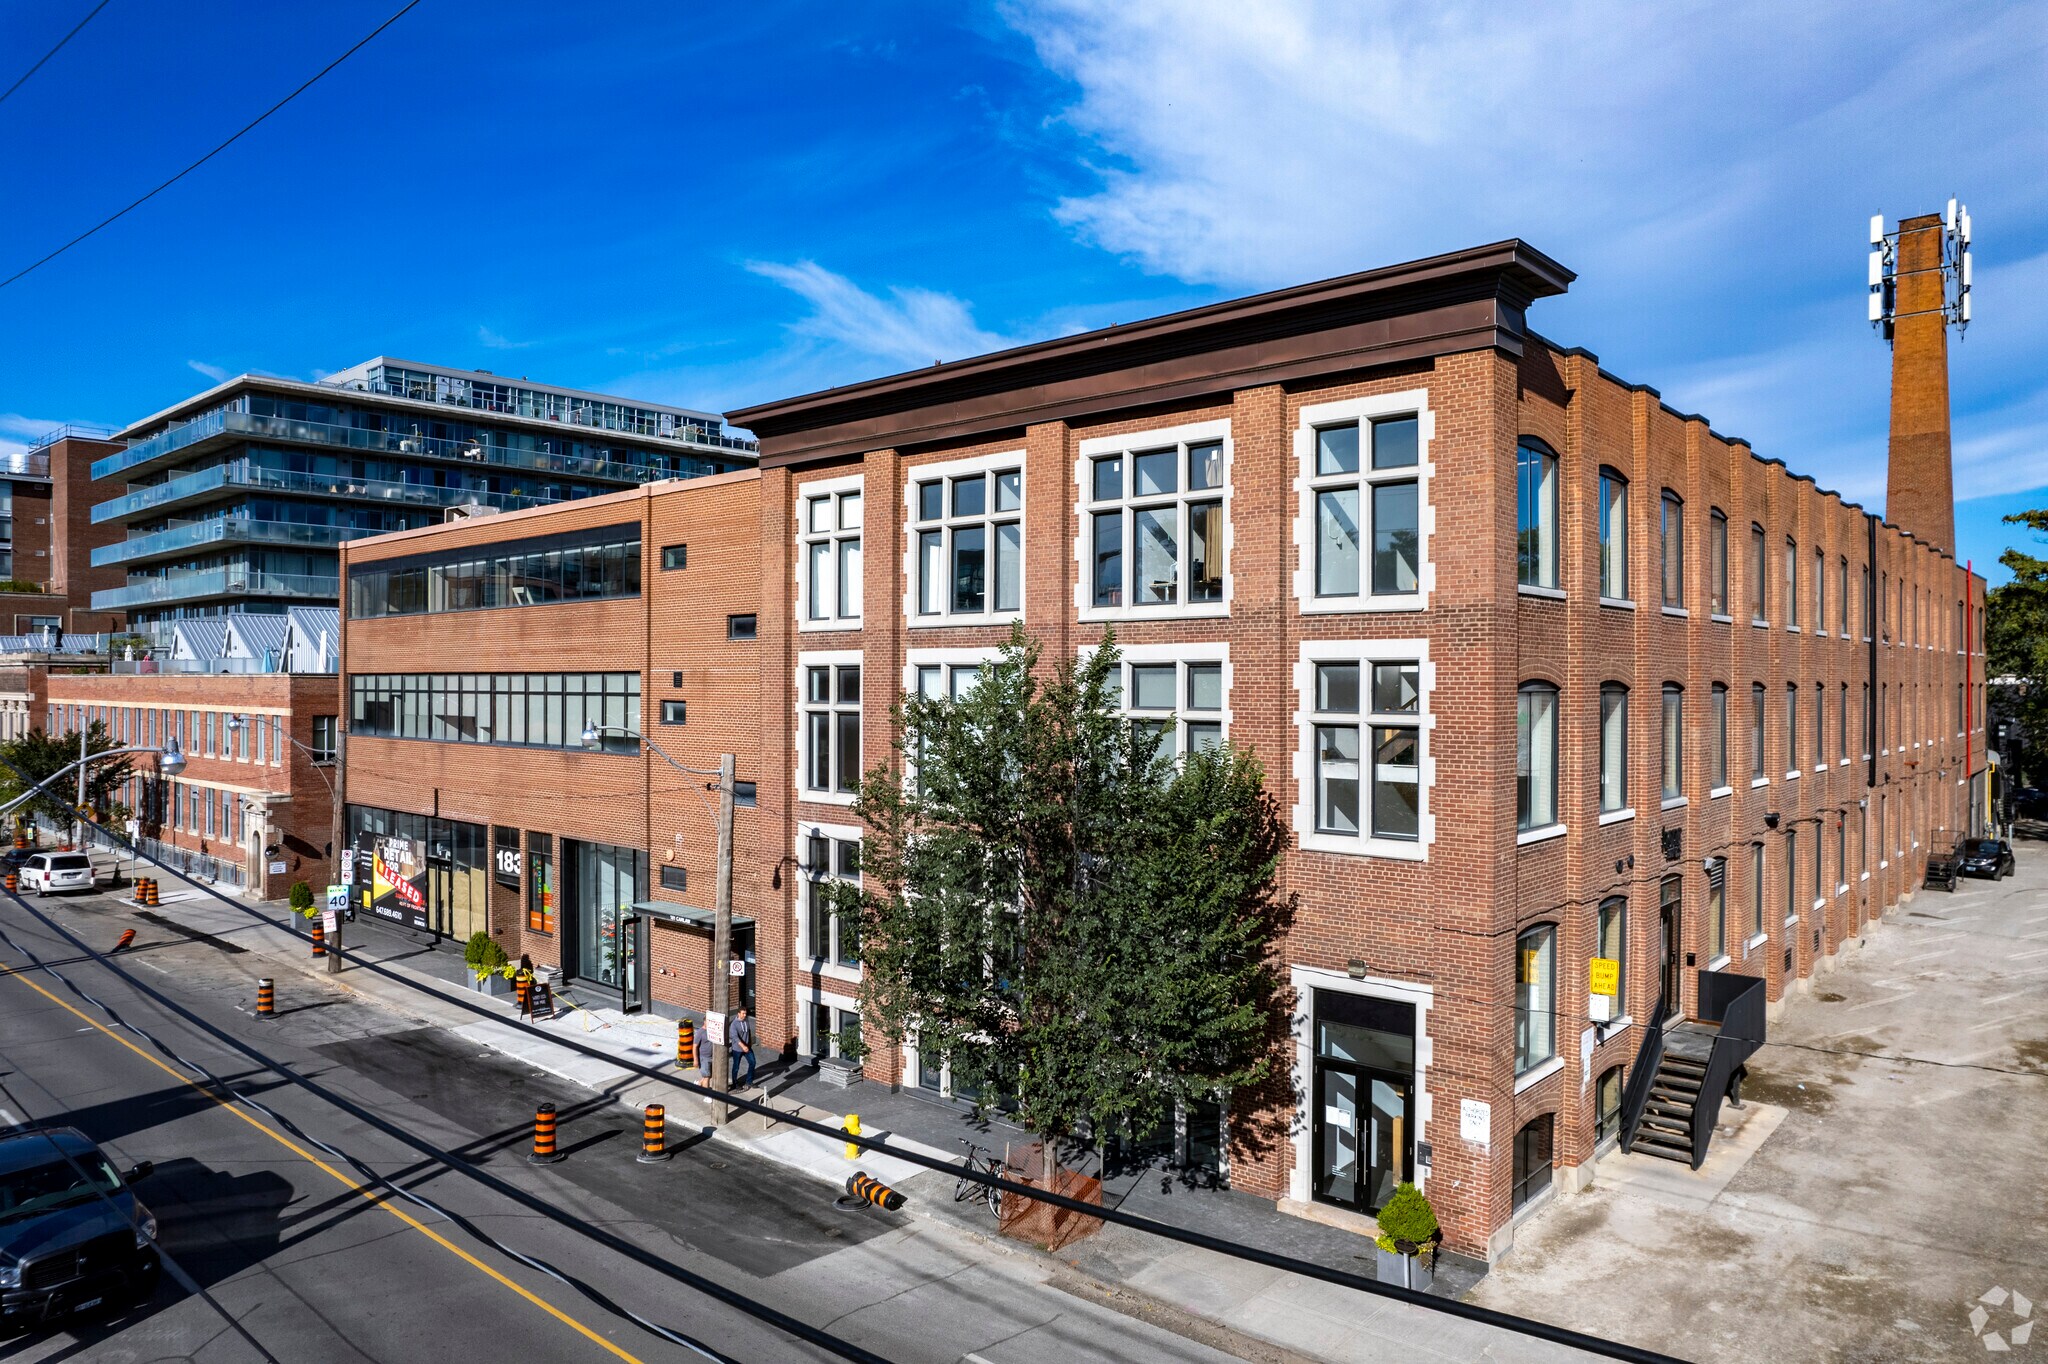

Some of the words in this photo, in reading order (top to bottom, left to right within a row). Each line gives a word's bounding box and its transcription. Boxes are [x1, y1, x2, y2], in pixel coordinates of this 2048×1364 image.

[389, 838, 408, 850] PRIME
[384, 846, 414, 865] RETAIL
[386, 860, 399, 873] FOR
[496, 849, 520, 875] 183
[384, 867, 420, 903] LEASED
[330, 895, 347, 907] 40
[1594, 962, 1615, 970] SPEED
[1596, 971, 1613, 980] BUMP
[1594, 982, 1615, 991] AHEAD
